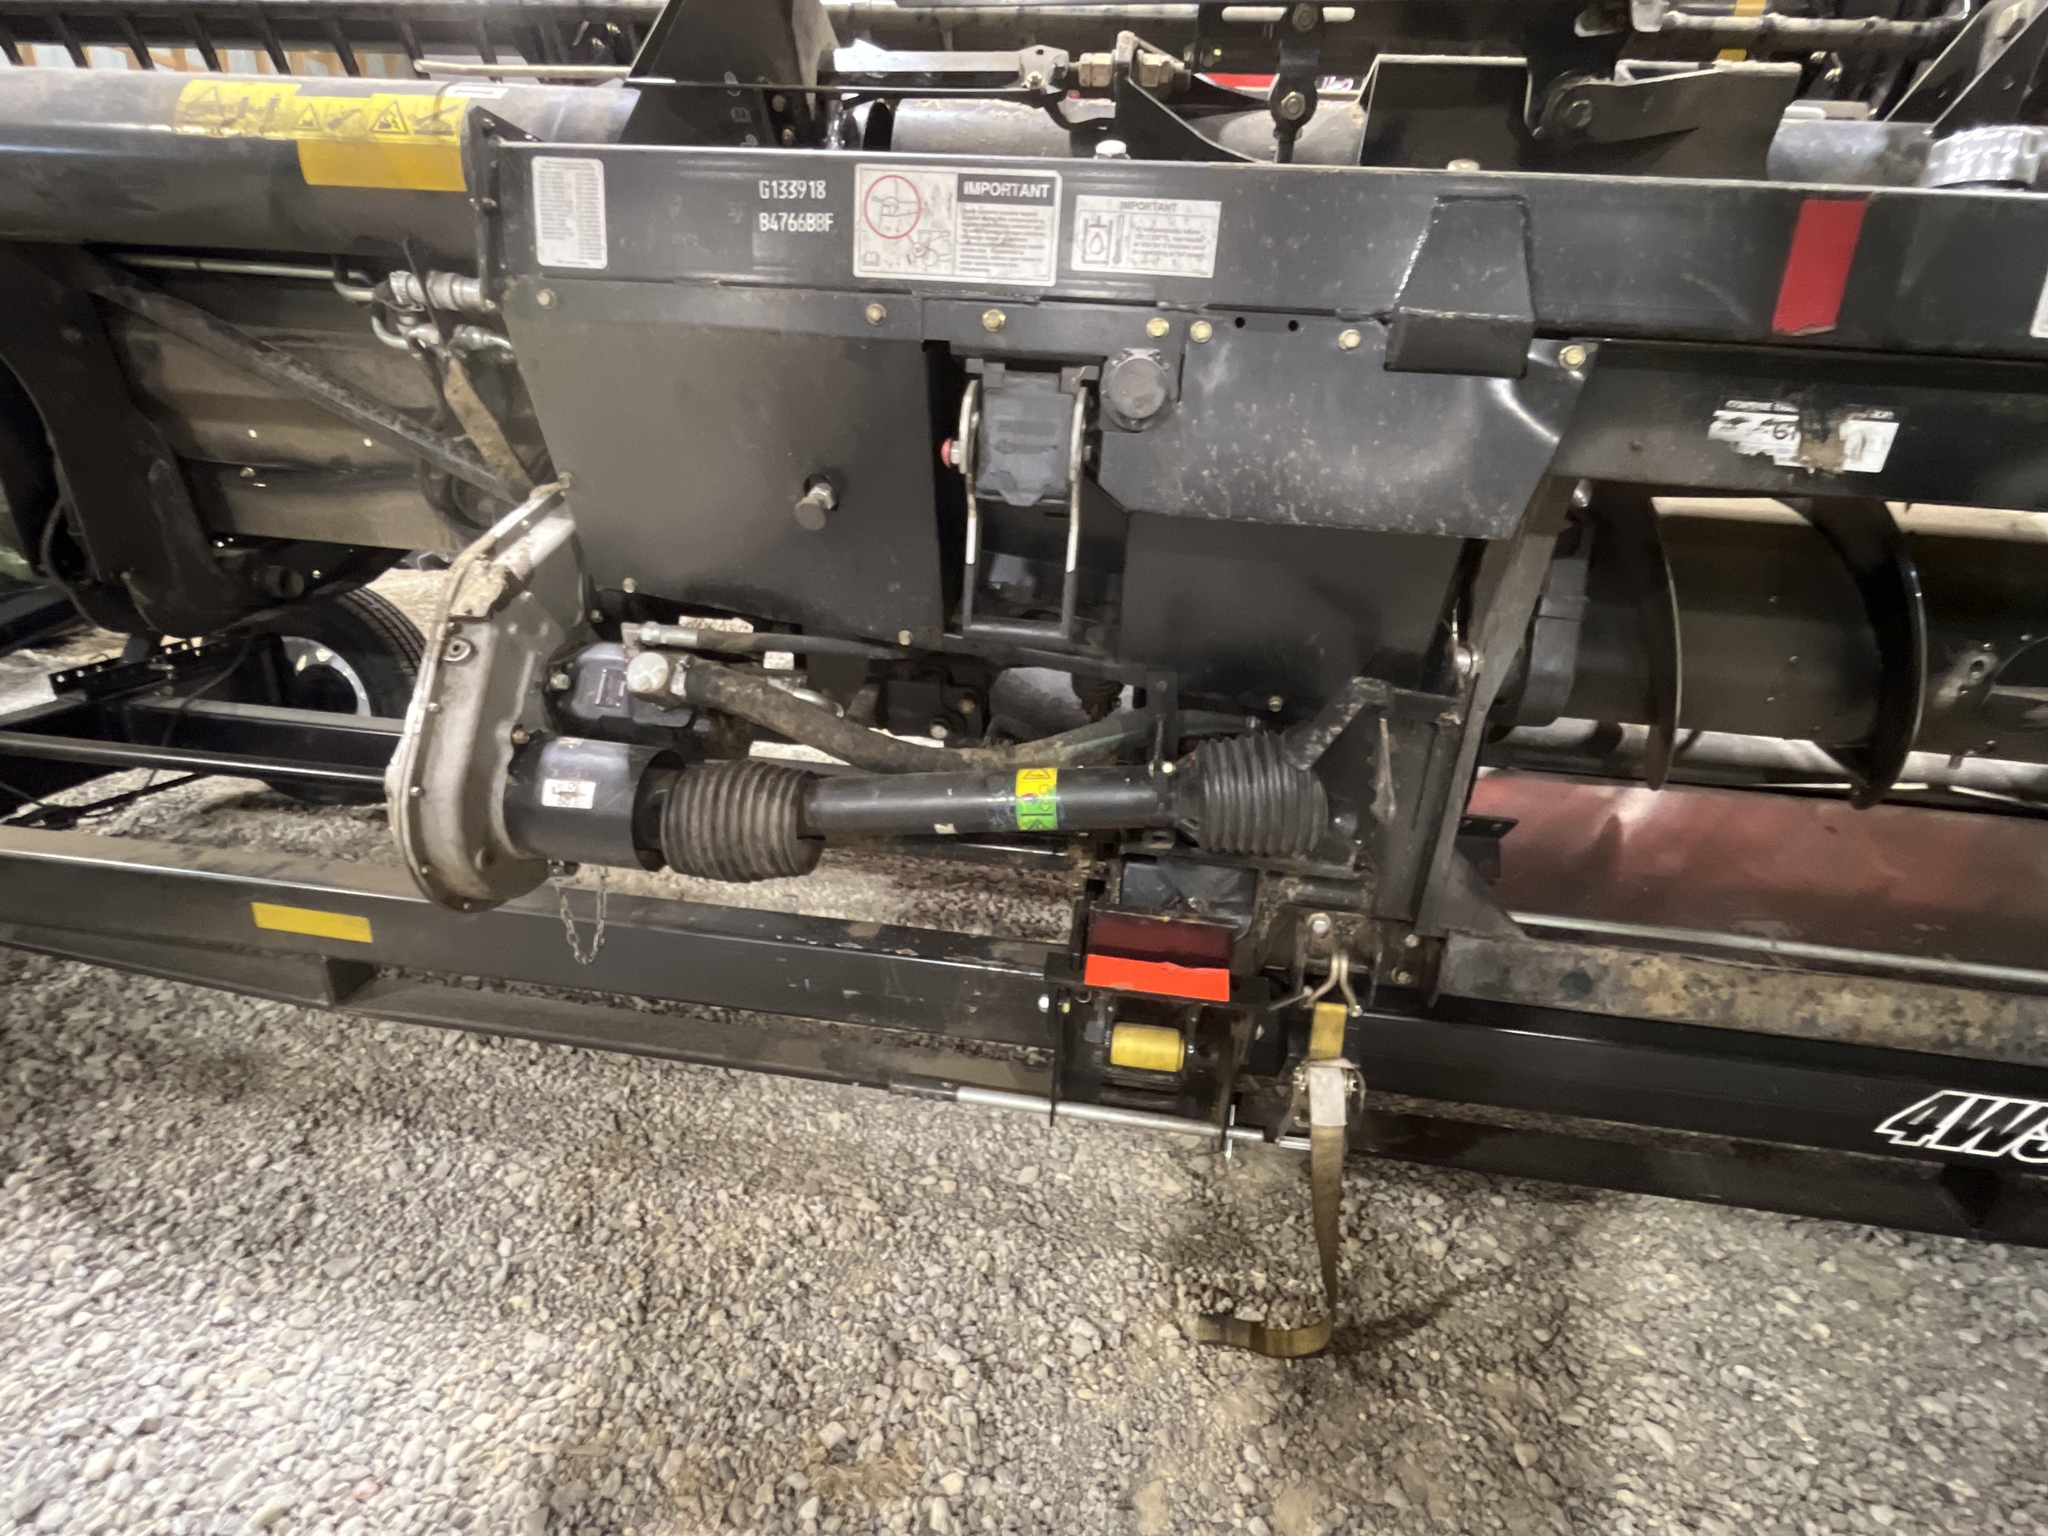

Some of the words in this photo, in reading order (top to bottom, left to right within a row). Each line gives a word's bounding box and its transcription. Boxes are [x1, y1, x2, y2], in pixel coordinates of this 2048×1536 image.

[758, 180, 827, 200] G133918
[963, 181, 1051, 199] IMPORTANT
[1119, 201, 1179, 213] IMPORTANT
